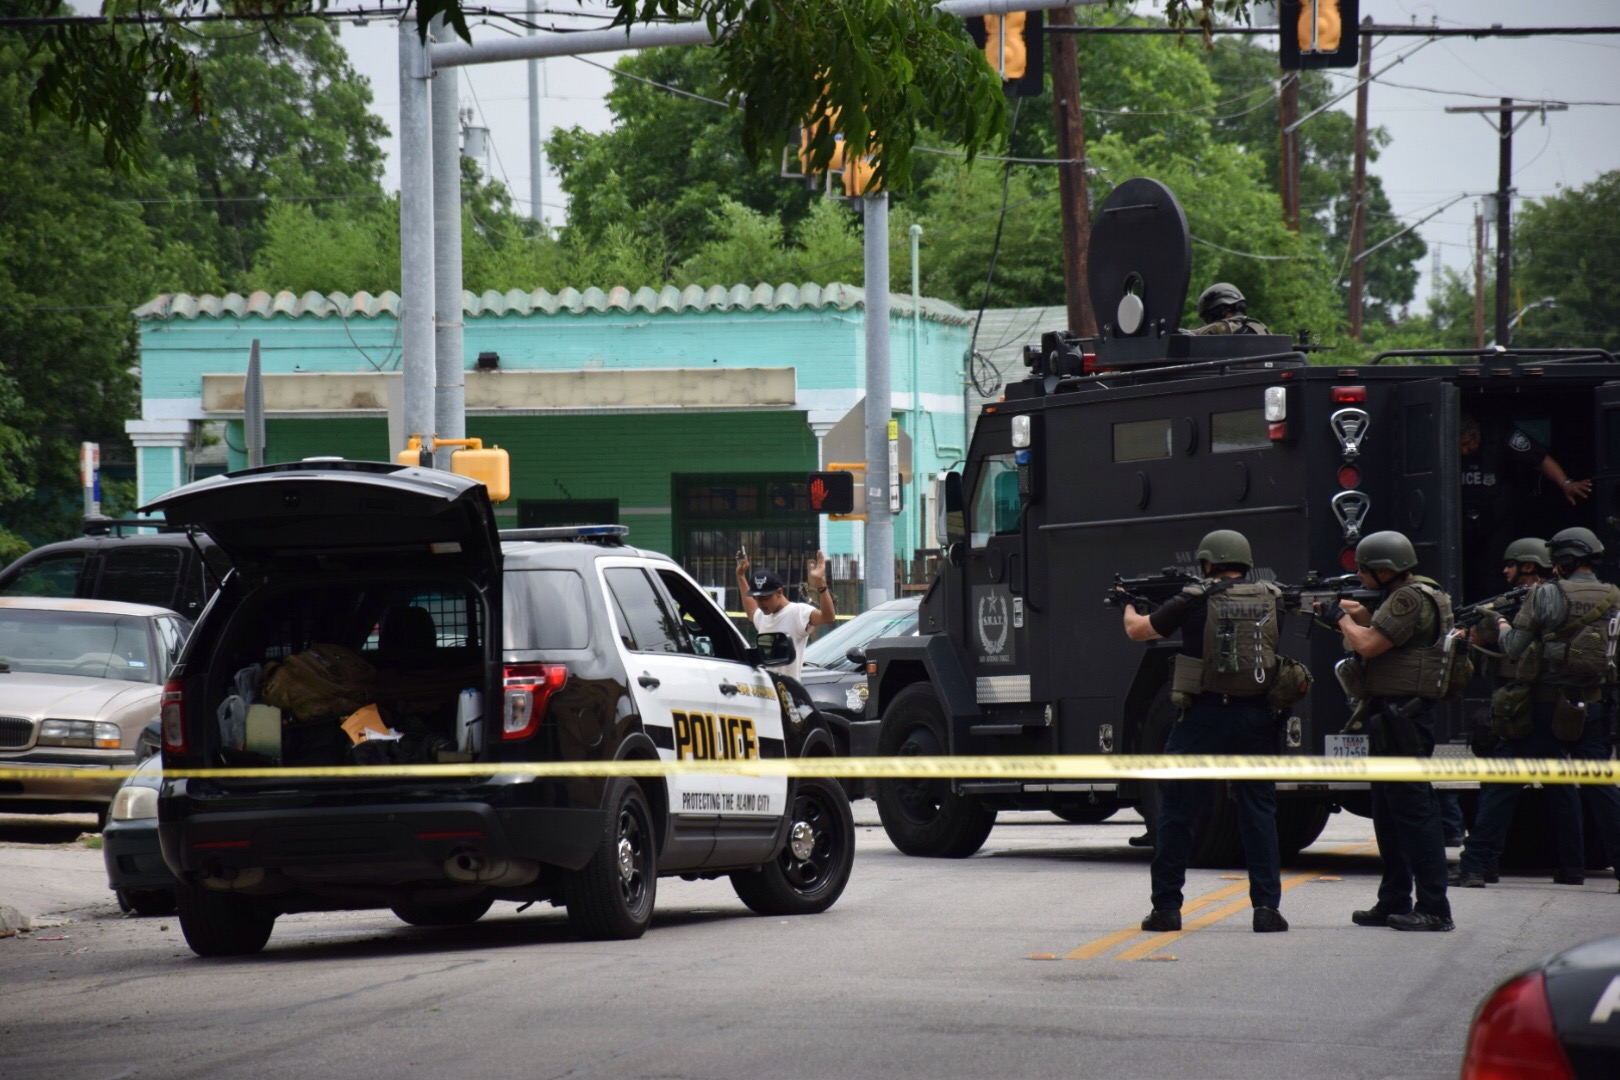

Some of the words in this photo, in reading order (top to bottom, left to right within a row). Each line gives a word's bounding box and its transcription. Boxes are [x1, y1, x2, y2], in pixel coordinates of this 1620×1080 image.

[1461, 472, 1482, 485] ICE
[1220, 602, 1270, 618] POLICE
[671, 709, 758, 760] POLICE
[682, 792, 720, 811] PROTECTING
[722, 793, 734, 811] THE
[736, 794, 756, 812] ALAMO
[757, 795, 770, 813] CITY
